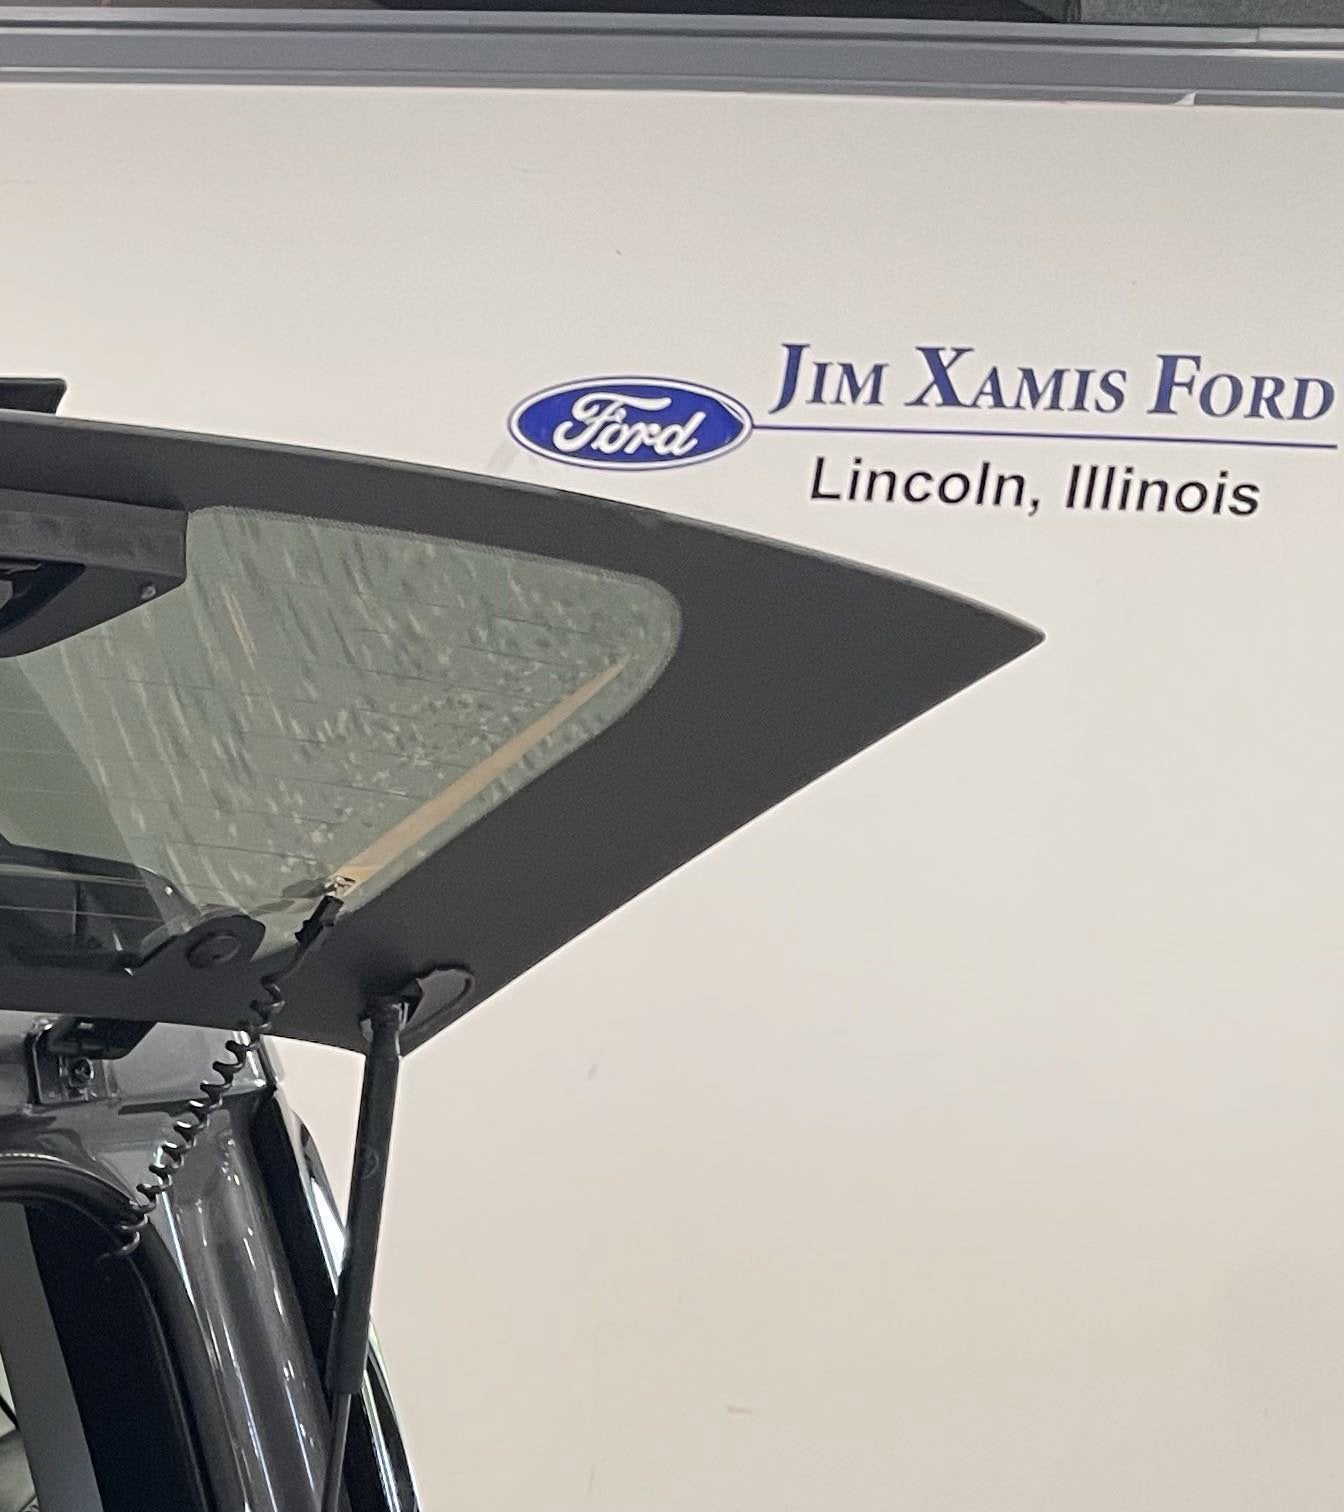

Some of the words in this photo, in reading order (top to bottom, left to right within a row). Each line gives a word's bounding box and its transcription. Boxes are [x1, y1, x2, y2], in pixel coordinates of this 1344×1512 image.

[552, 391, 707, 457] Ford
[810, 455, 1040, 517] Lincoln,
[1065, 463, 1262, 518] Illinois
